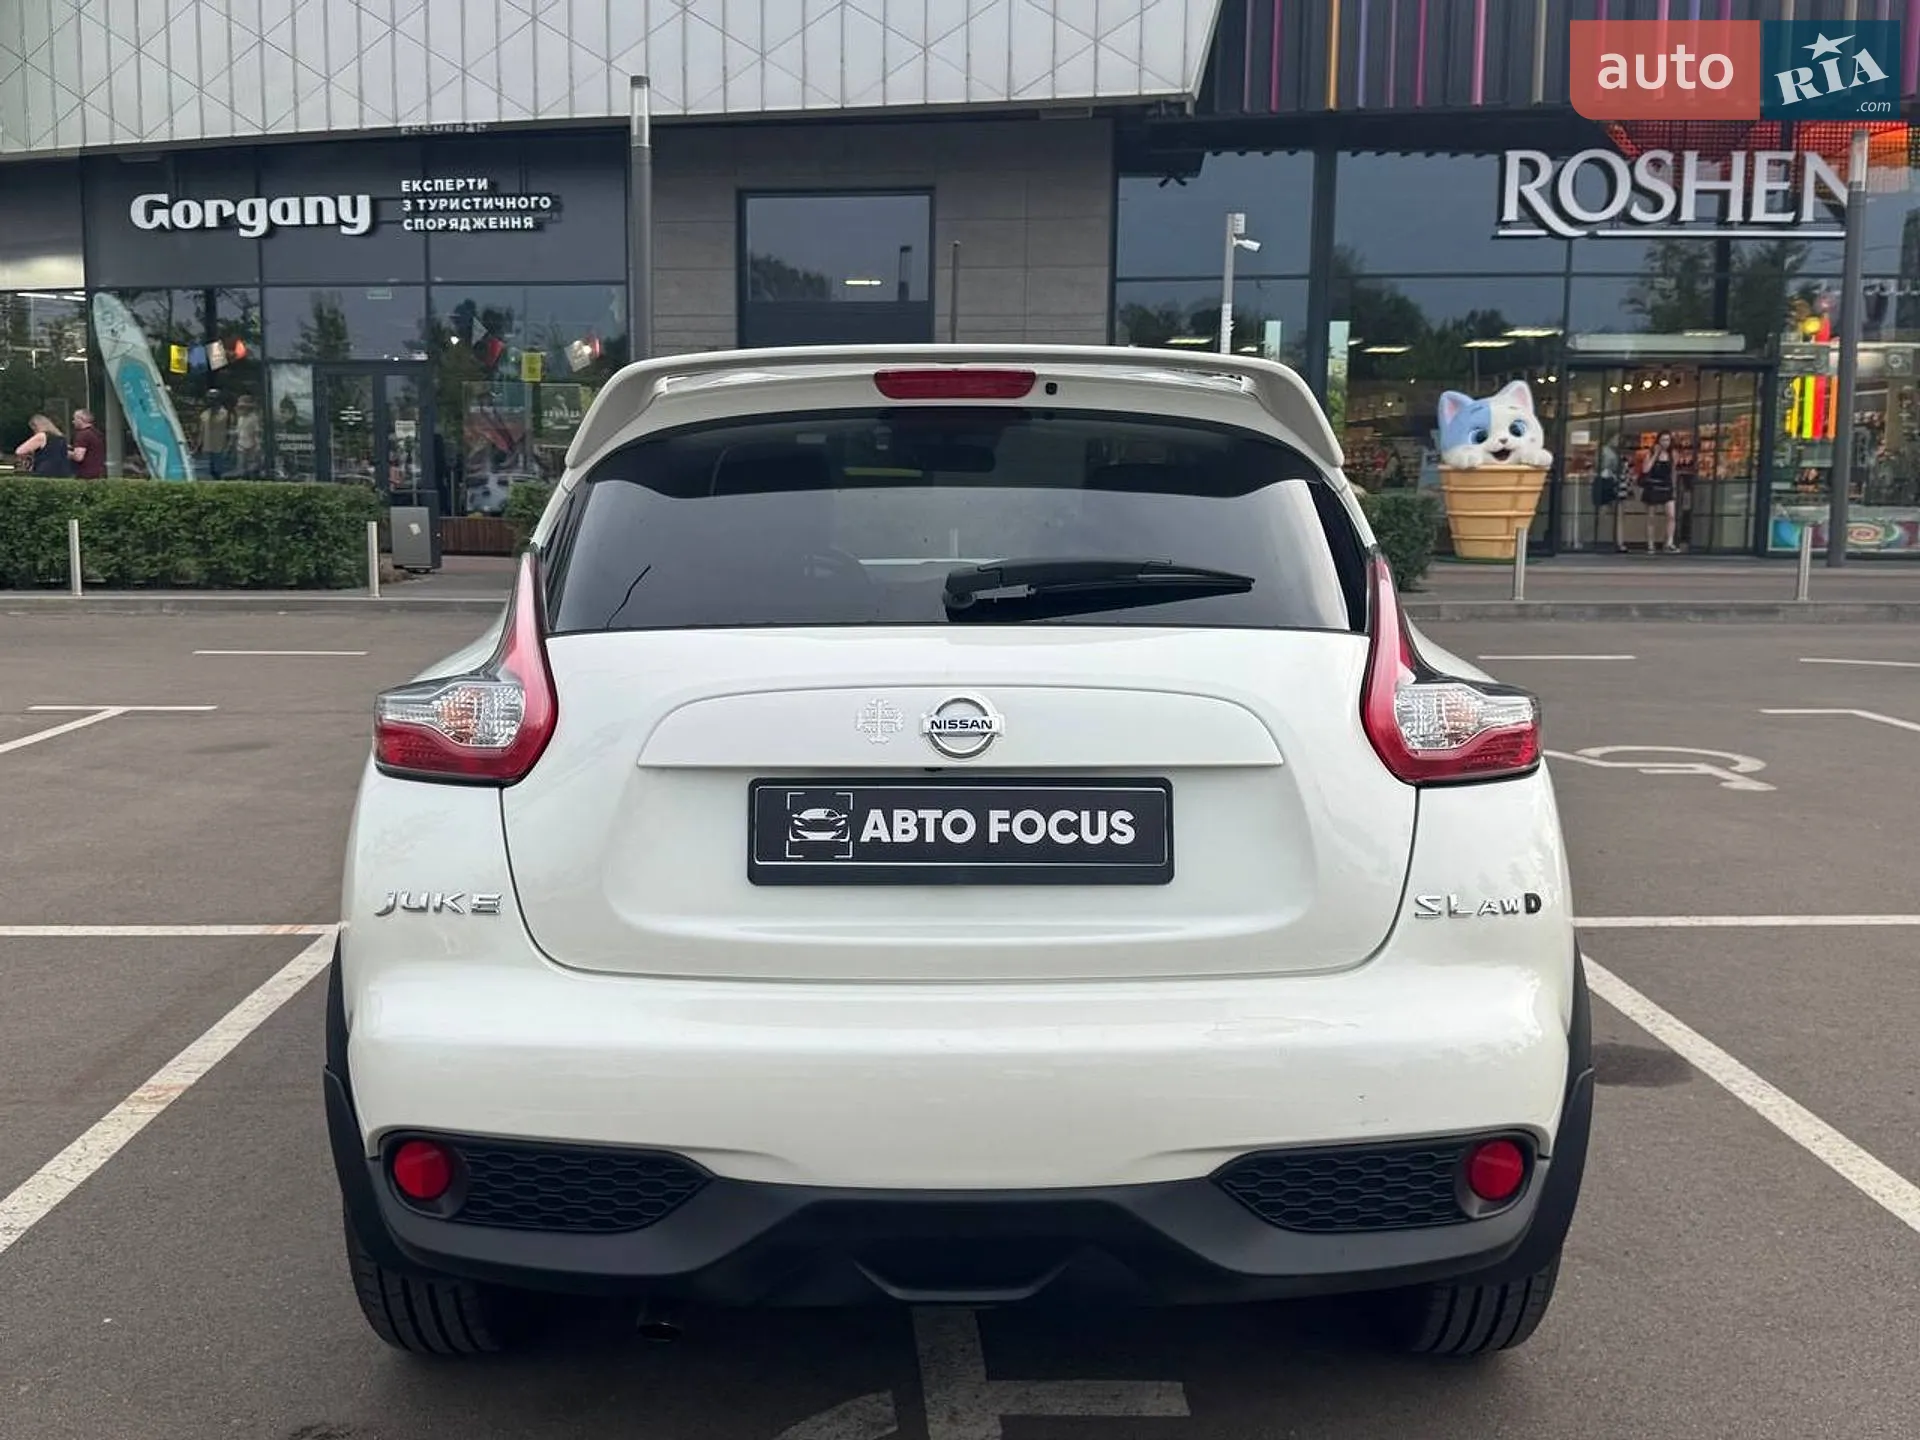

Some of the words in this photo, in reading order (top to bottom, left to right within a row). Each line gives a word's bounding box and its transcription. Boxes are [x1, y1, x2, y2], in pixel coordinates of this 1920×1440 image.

[401, 178, 488, 192] ЕКСПЕРТИ
[1501, 149, 1848, 237] ROSHEN
[417, 196, 552, 211] ТУРИСТИЧНОГО
[130, 193, 371, 237] Gorgany
[403, 216, 534, 231] СПОРЯДЖЕННЯ
[931, 719, 993, 730] NISSAN
[988, 809, 1136, 845] FOCUS
[374, 890, 503, 917] JUKE
